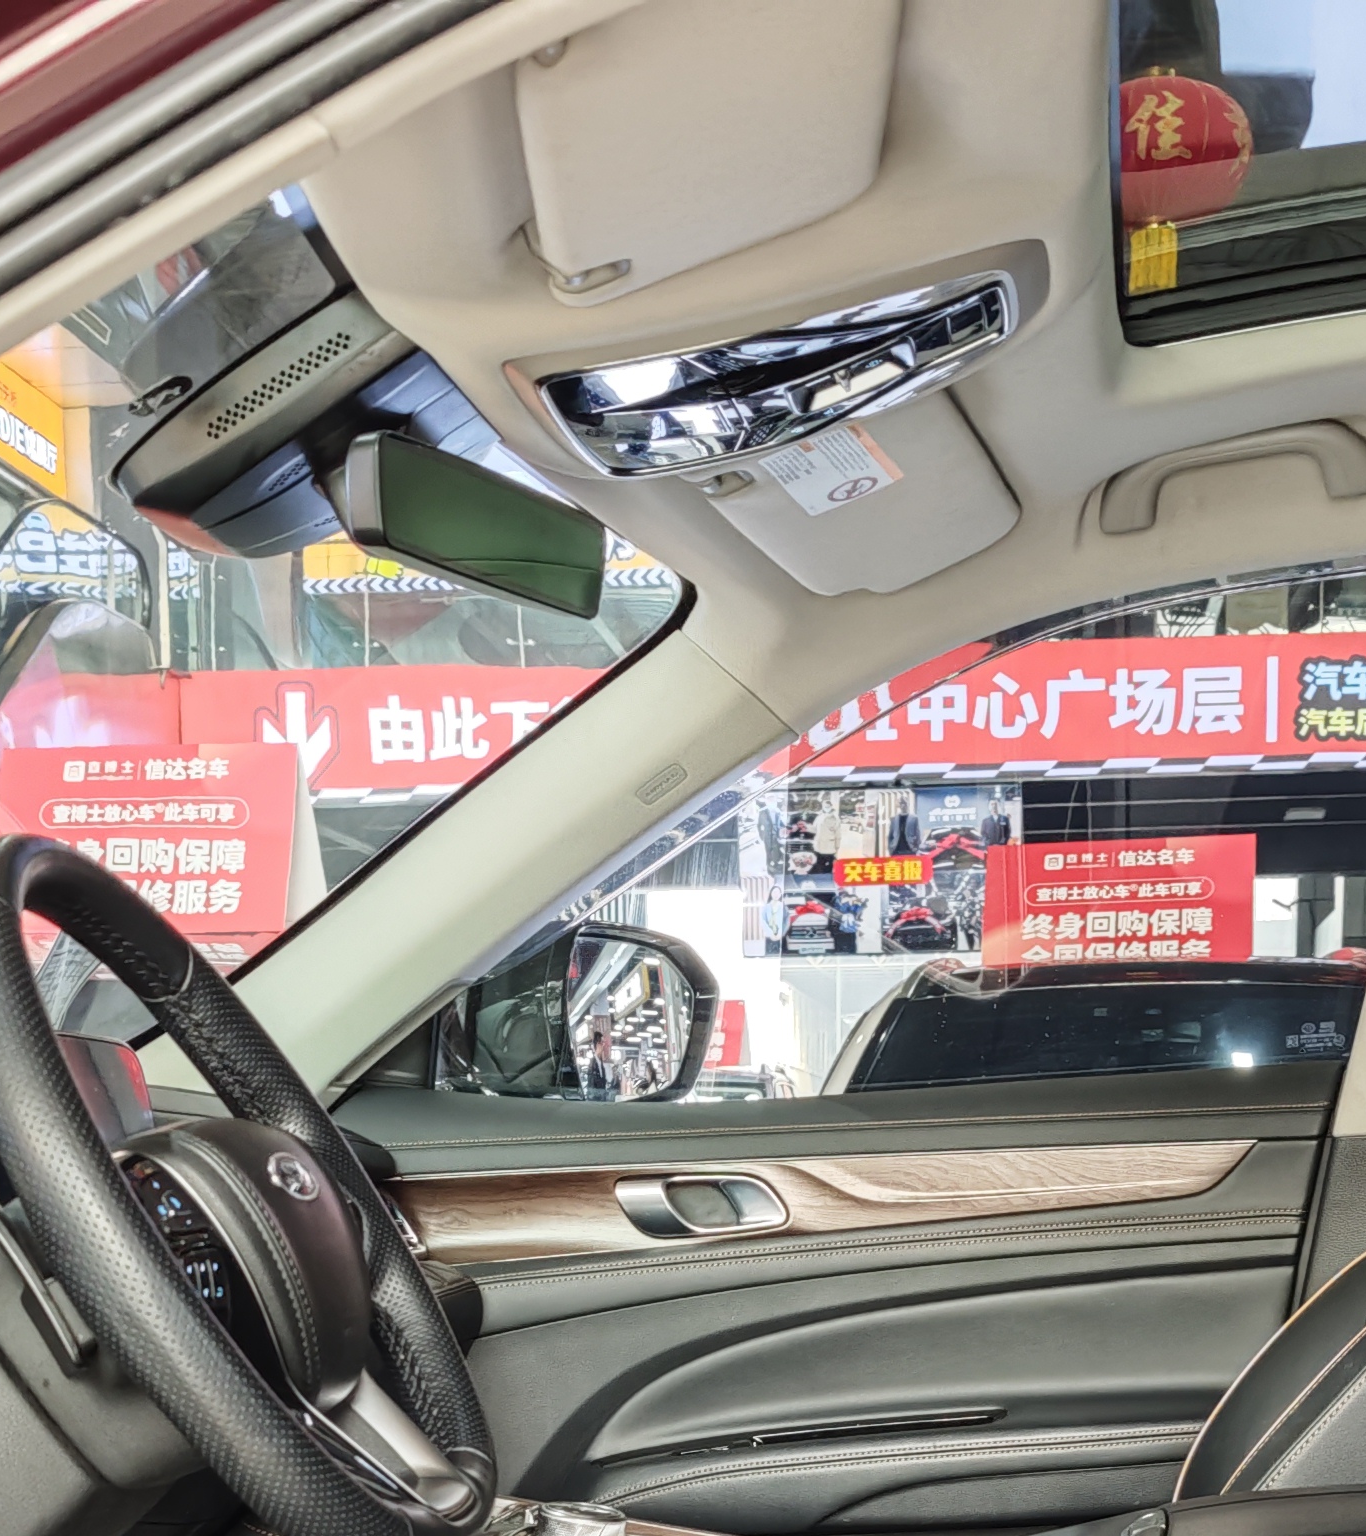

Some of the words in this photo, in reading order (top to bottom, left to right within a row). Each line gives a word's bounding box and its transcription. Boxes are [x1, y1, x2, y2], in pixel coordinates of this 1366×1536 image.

[1125, 90, 1192, 160] 佳
[368, 695, 573, 764] 由此下
[144, 758, 230, 781] 信达名车
[843, 860, 923, 883] 交车喜报
[1118, 848, 1195, 867] 信达名车
[1021, 906, 1214, 941] 终身回购保障
